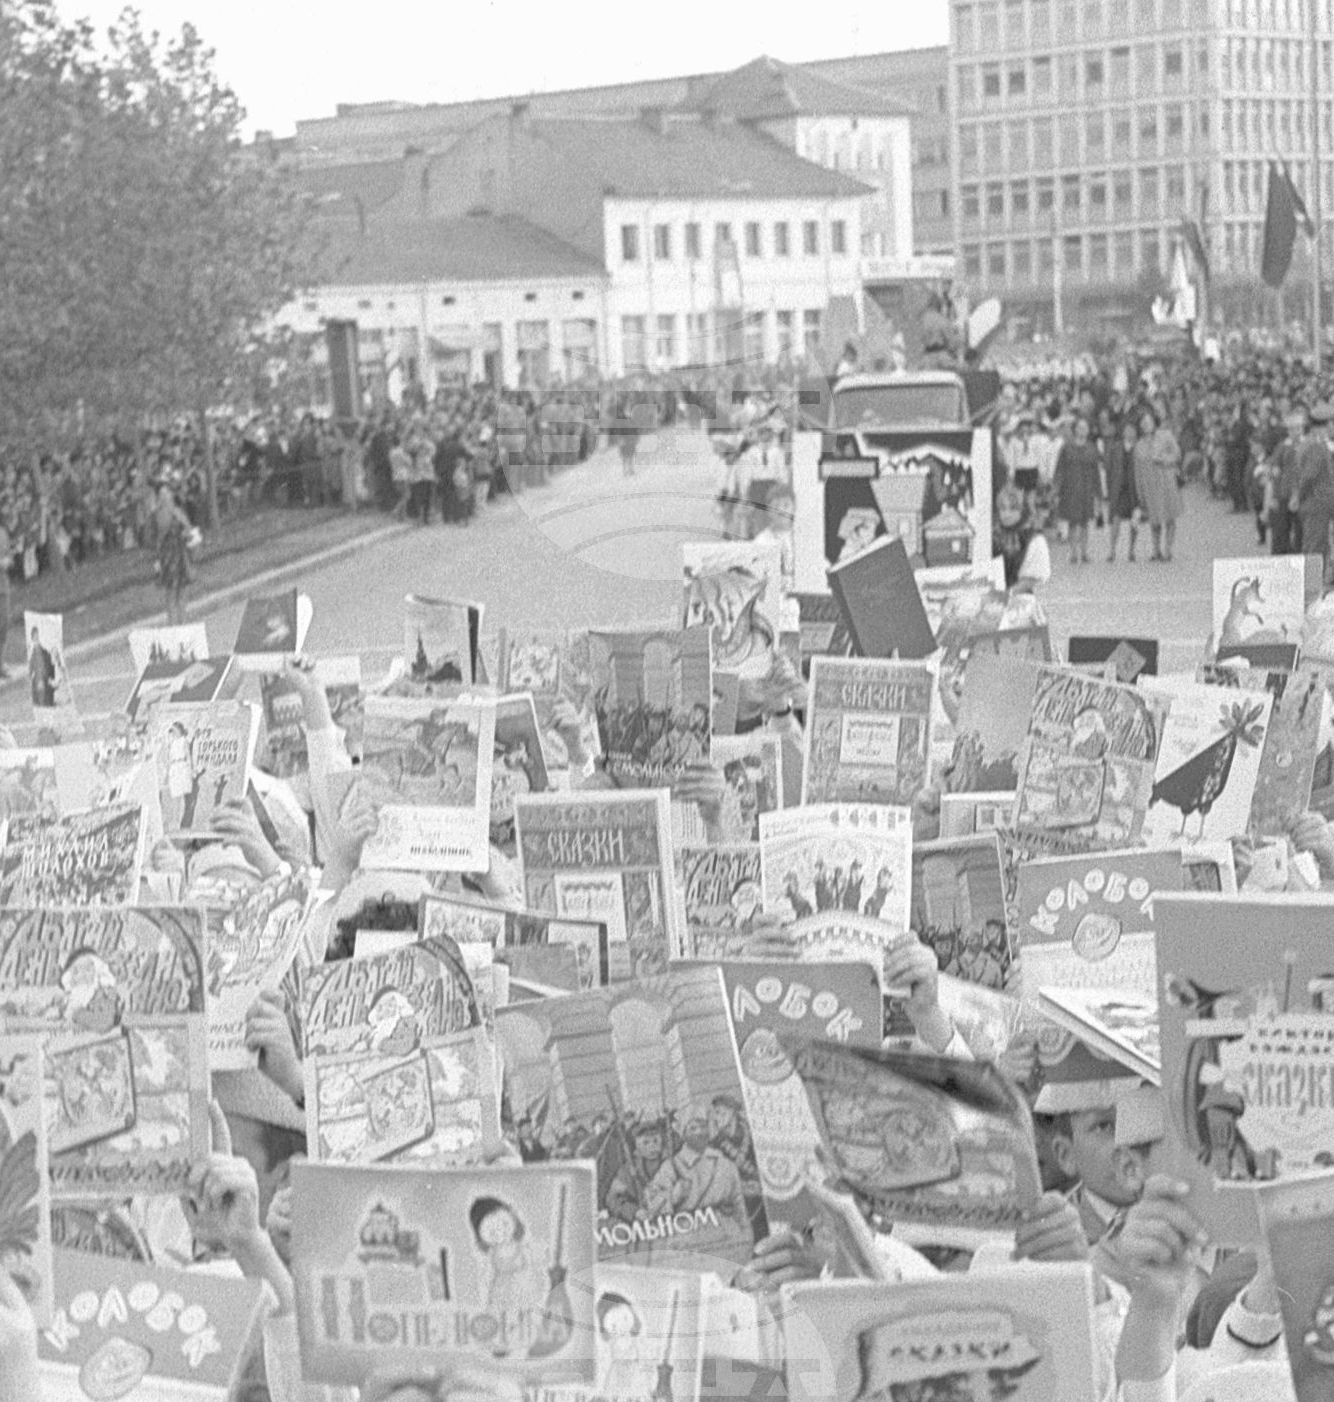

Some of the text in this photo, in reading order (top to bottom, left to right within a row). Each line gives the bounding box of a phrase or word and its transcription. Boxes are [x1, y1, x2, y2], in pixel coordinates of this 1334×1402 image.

[21, 850, 109, 878] ШОЛОХОВ
[22, 832, 109, 862] МИХАИЛ
[547, 829, 624, 867] СКАЗКИ
[732, 976, 864, 1043] ЛОБОК
[593, 1205, 720, 1247] МОЛЬНОМ
[44, 1281, 222, 1367] КОЛОБОК
[889, 1341, 1011, 1364] СКАЗКИ
